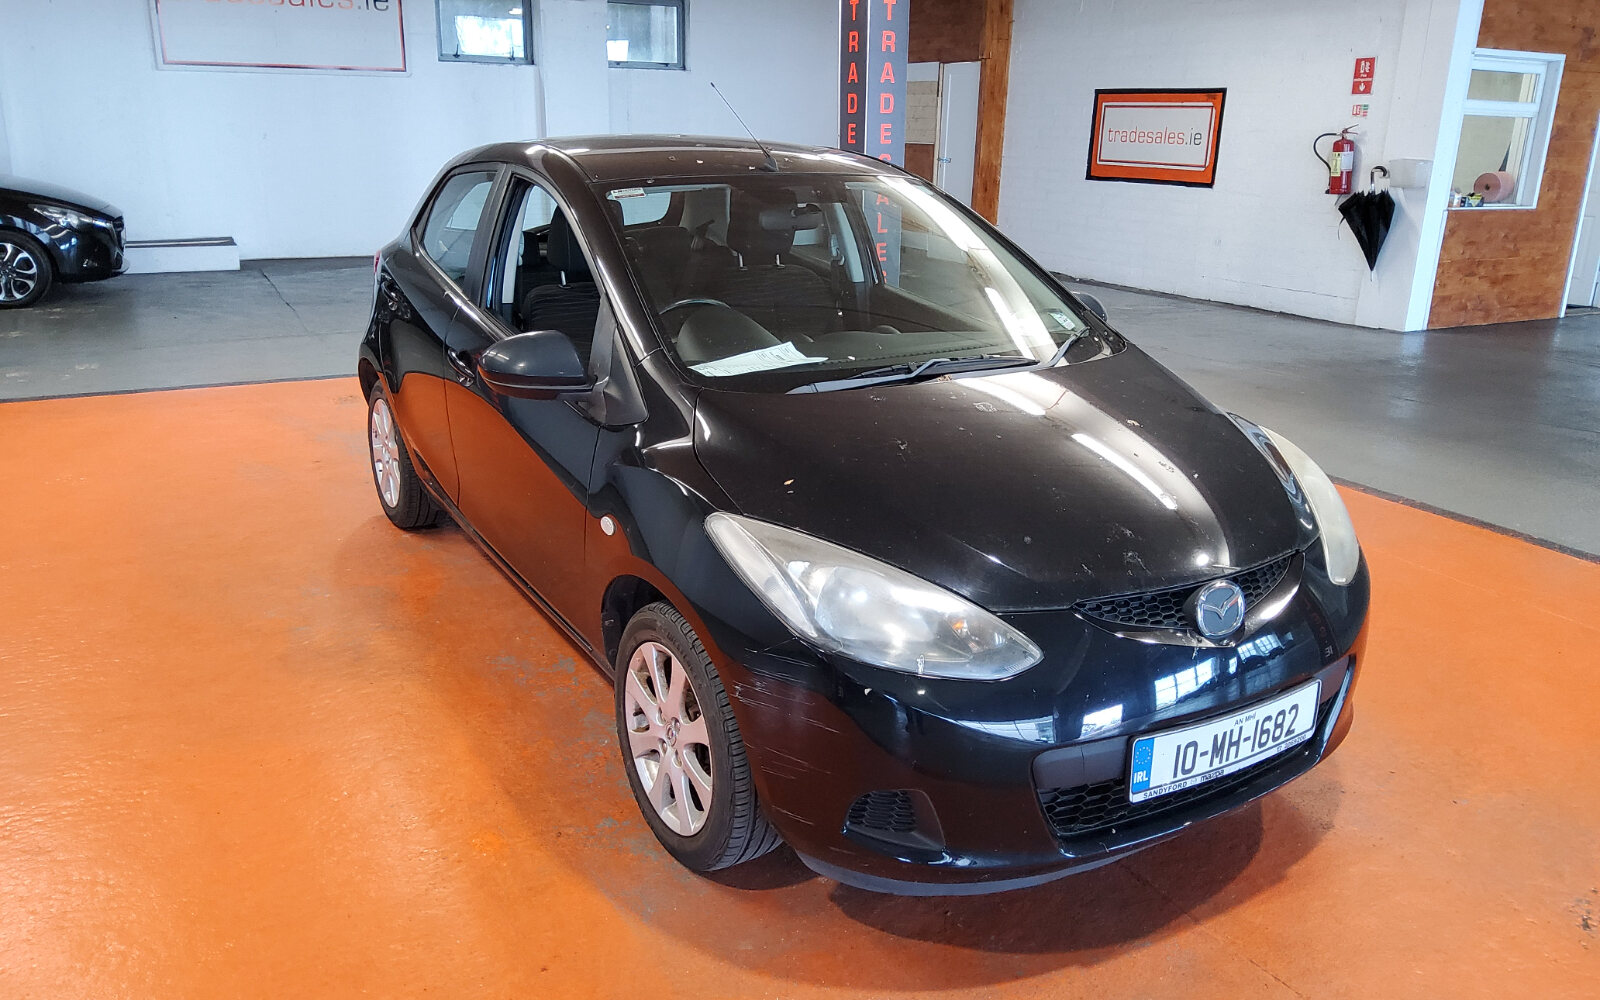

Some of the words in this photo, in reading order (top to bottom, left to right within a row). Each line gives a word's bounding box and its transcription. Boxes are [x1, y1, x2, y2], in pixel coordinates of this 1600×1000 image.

[847, 0, 859, 144] TRADE
[1107, 126, 1203, 146] tradesales.ie
[1172, 703, 1299, 779] 10-MH-1682
[1133, 770, 1149, 784] IRL
[1143, 781, 1188, 799] SANDYFORD
